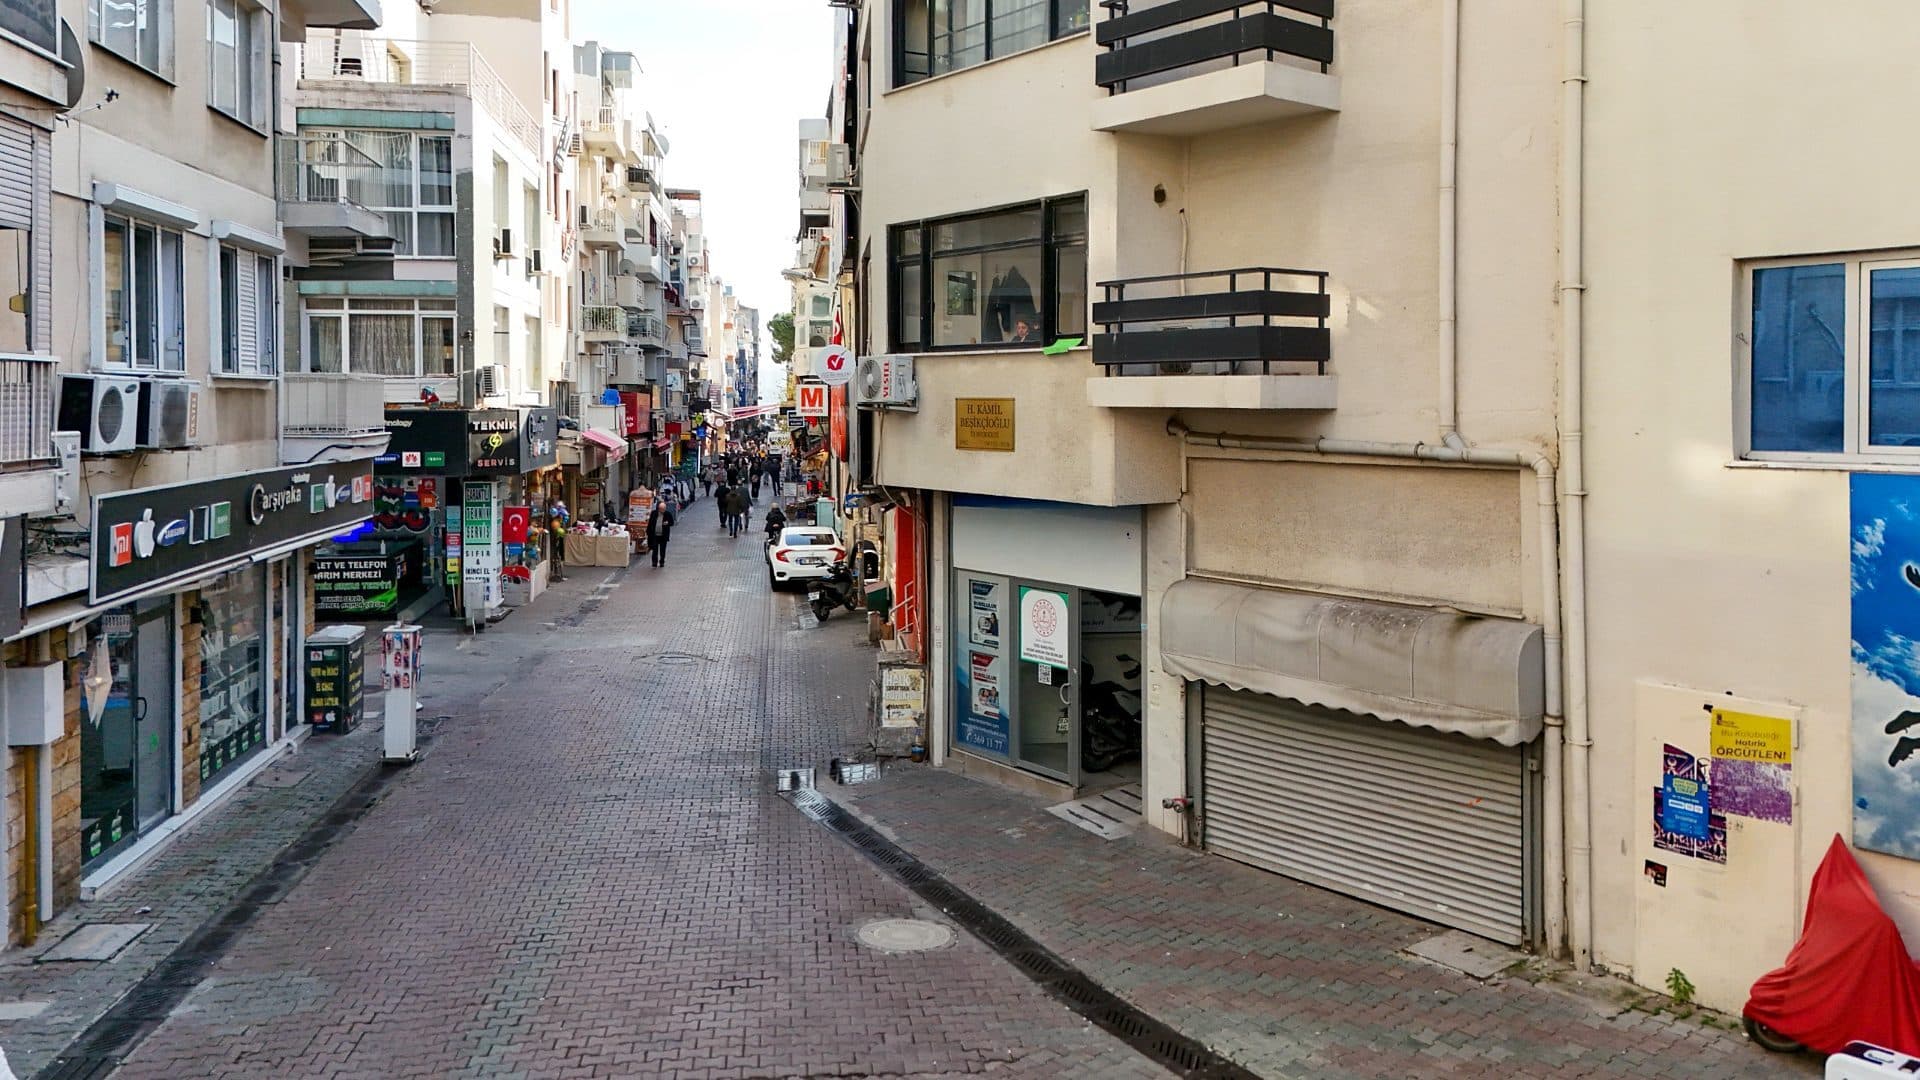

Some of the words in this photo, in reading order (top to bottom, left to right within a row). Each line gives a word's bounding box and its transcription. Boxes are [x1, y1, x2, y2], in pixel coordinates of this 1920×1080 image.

[801, 388, 823, 408] M
[473, 418, 517, 431] TEKNİK
[477, 457, 515, 467] SERVİS
[334, 561, 345, 569] VE
[348, 560, 387, 569] TELEFON
[342, 569, 382, 579] MERKEZİ
[1734, 739, 1767, 747] Hatırla
[1716, 745, 1787, 760] ÖRGÜTLEN!
